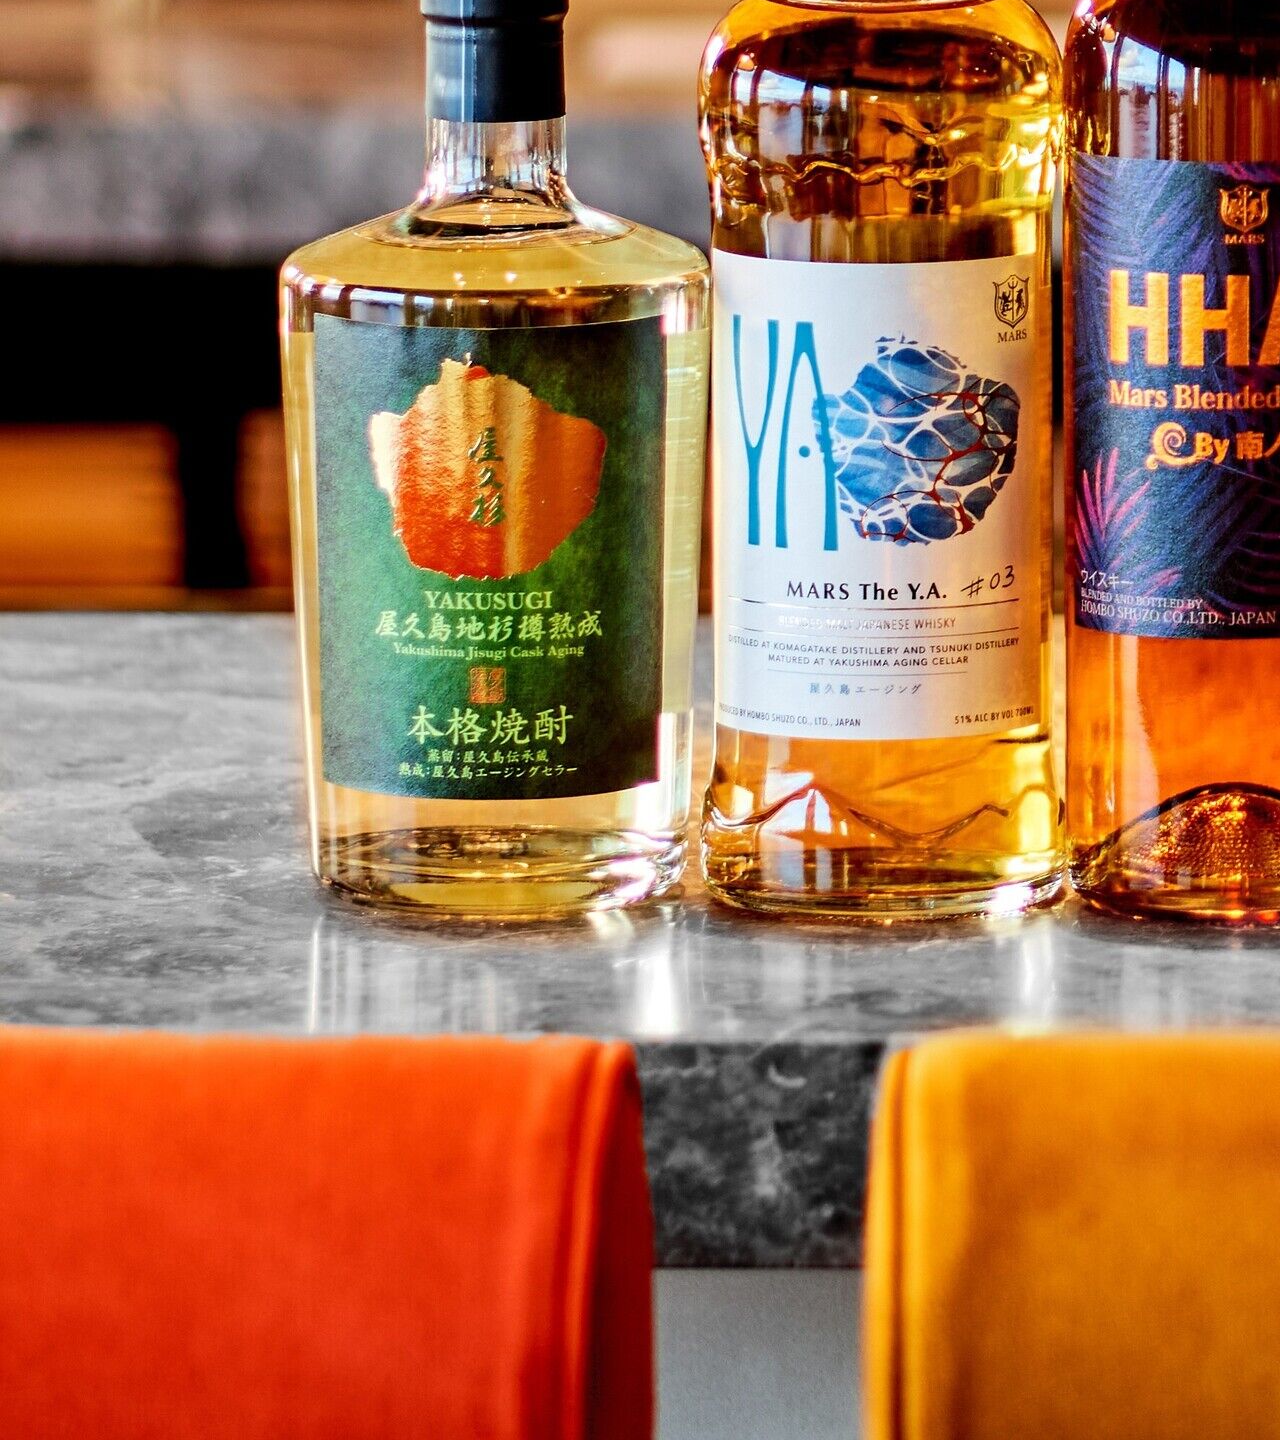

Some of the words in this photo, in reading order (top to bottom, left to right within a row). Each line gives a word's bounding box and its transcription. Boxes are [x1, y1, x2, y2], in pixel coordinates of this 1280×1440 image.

[997, 329, 1028, 344] MARS
[1108, 379, 1167, 407] Mars
[1173, 383, 1280, 409] Blended
[1080, 568, 1134, 589] ウイスキー
[787, 580, 850, 601] MARS
[859, 583, 899, 601] The
[907, 582, 947, 601] Y.A.
[1081, 587, 1113, 602] BLENDED
[1114, 593, 1134, 605] AND
[1136, 596, 1185, 609] BOTTLED
[1187, 599, 1204, 609] BY
[425, 591, 553, 610] YAKUSUGI
[1081, 600, 1115, 617] HOMBO
[1118, 606, 1160, 622] SHUZO
[1229, 611, 1277, 625] JAPAN
[375, 610, 602, 642] 屋久島地杉樽熟成
[914, 617, 956, 630] WHISKY
[393, 642, 464, 658] Yakushima
[465, 648, 507, 661] Jisugi
[510, 646, 544, 658] Cask
[548, 644, 585, 658] Aging
[761, 640, 771, 649] AT
[773, 642, 837, 654] KOMAGATAKE
[842, 646, 899, 655] DISTILLERY
[903, 645, 926, 655] AND
[930, 643, 973, 654] TSUNUKI
[975, 637, 1020, 651] DISTILLERY
[768, 654, 810, 665] MATURED
[813, 656, 826, 666] AT
[829, 658, 889, 667] YAKUSHIMA
[893, 659, 928, 667] AGING
[932, 656, 969, 666] CELLAR
[407, 705, 574, 745] 本格焼酎
[772, 713, 796, 724] SHUZO
[835, 718, 861, 727] JAPAN
[954, 714, 972, 725] 51%
[974, 712, 988, 722] ALC
[991, 711, 1000, 721] BY
